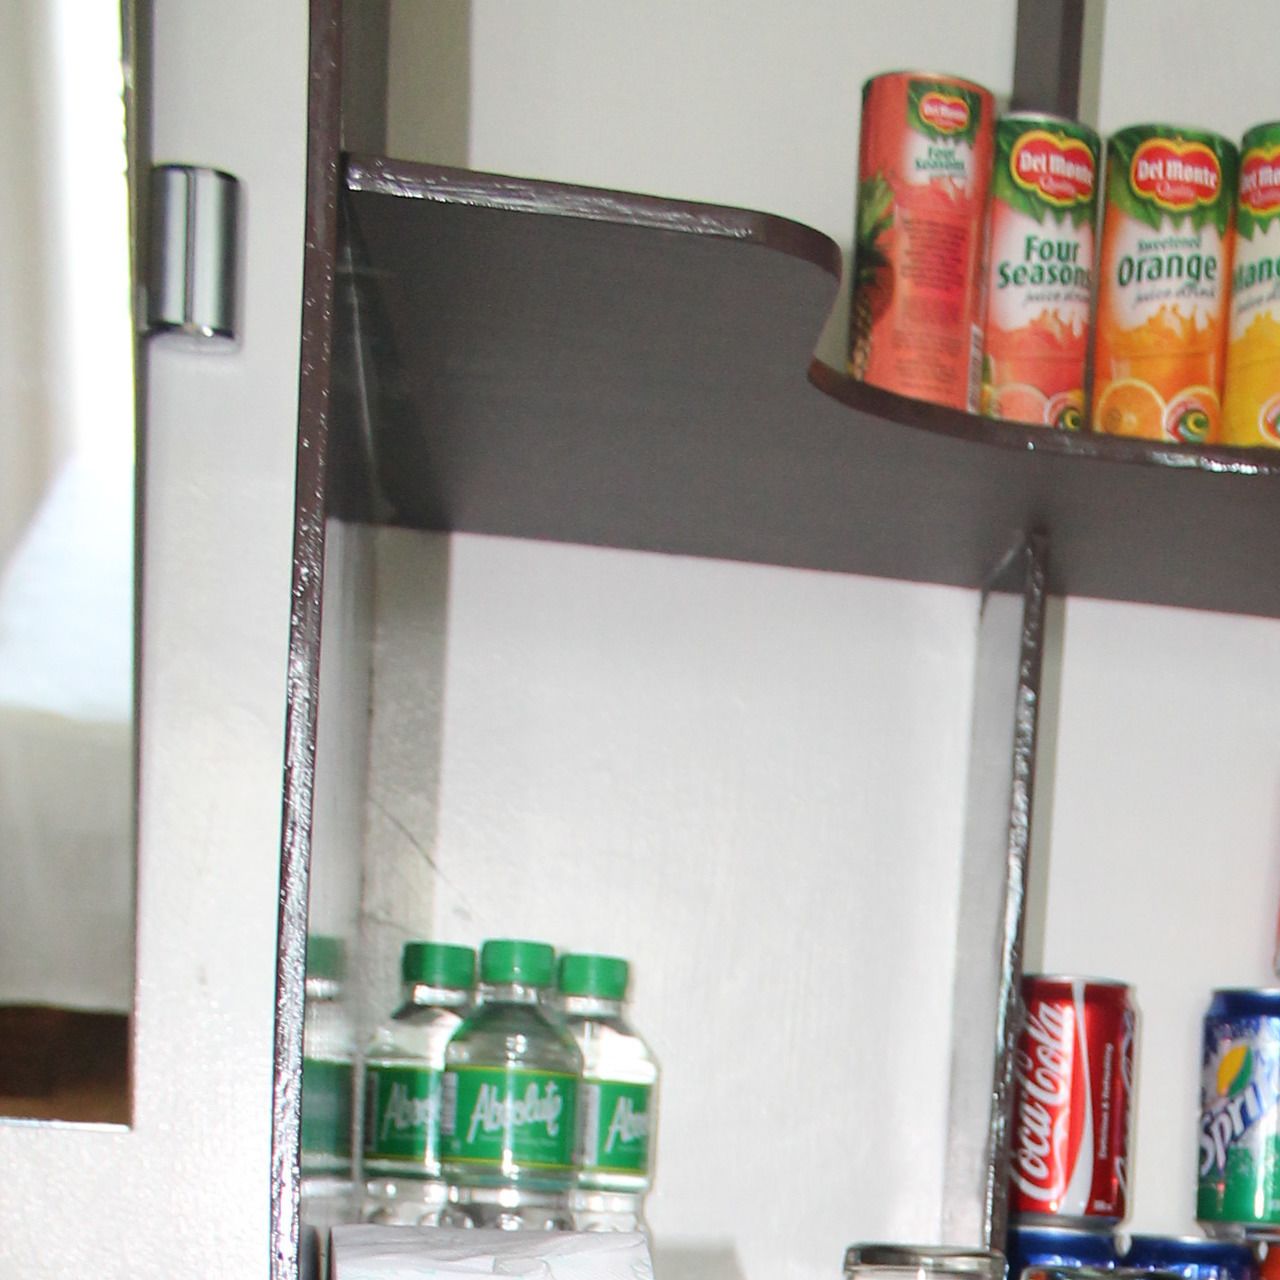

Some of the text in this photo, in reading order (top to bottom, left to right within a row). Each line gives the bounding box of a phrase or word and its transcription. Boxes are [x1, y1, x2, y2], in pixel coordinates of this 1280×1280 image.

[1021, 150, 1046, 173] Del
[1049, 154, 1092, 186] Monte
[1138, 159, 1217, 188] Del Monte
[1024, 234, 1080, 262] Four
[1118, 252, 1217, 288] Orange
[471, 1080, 562, 1143] Absolute
